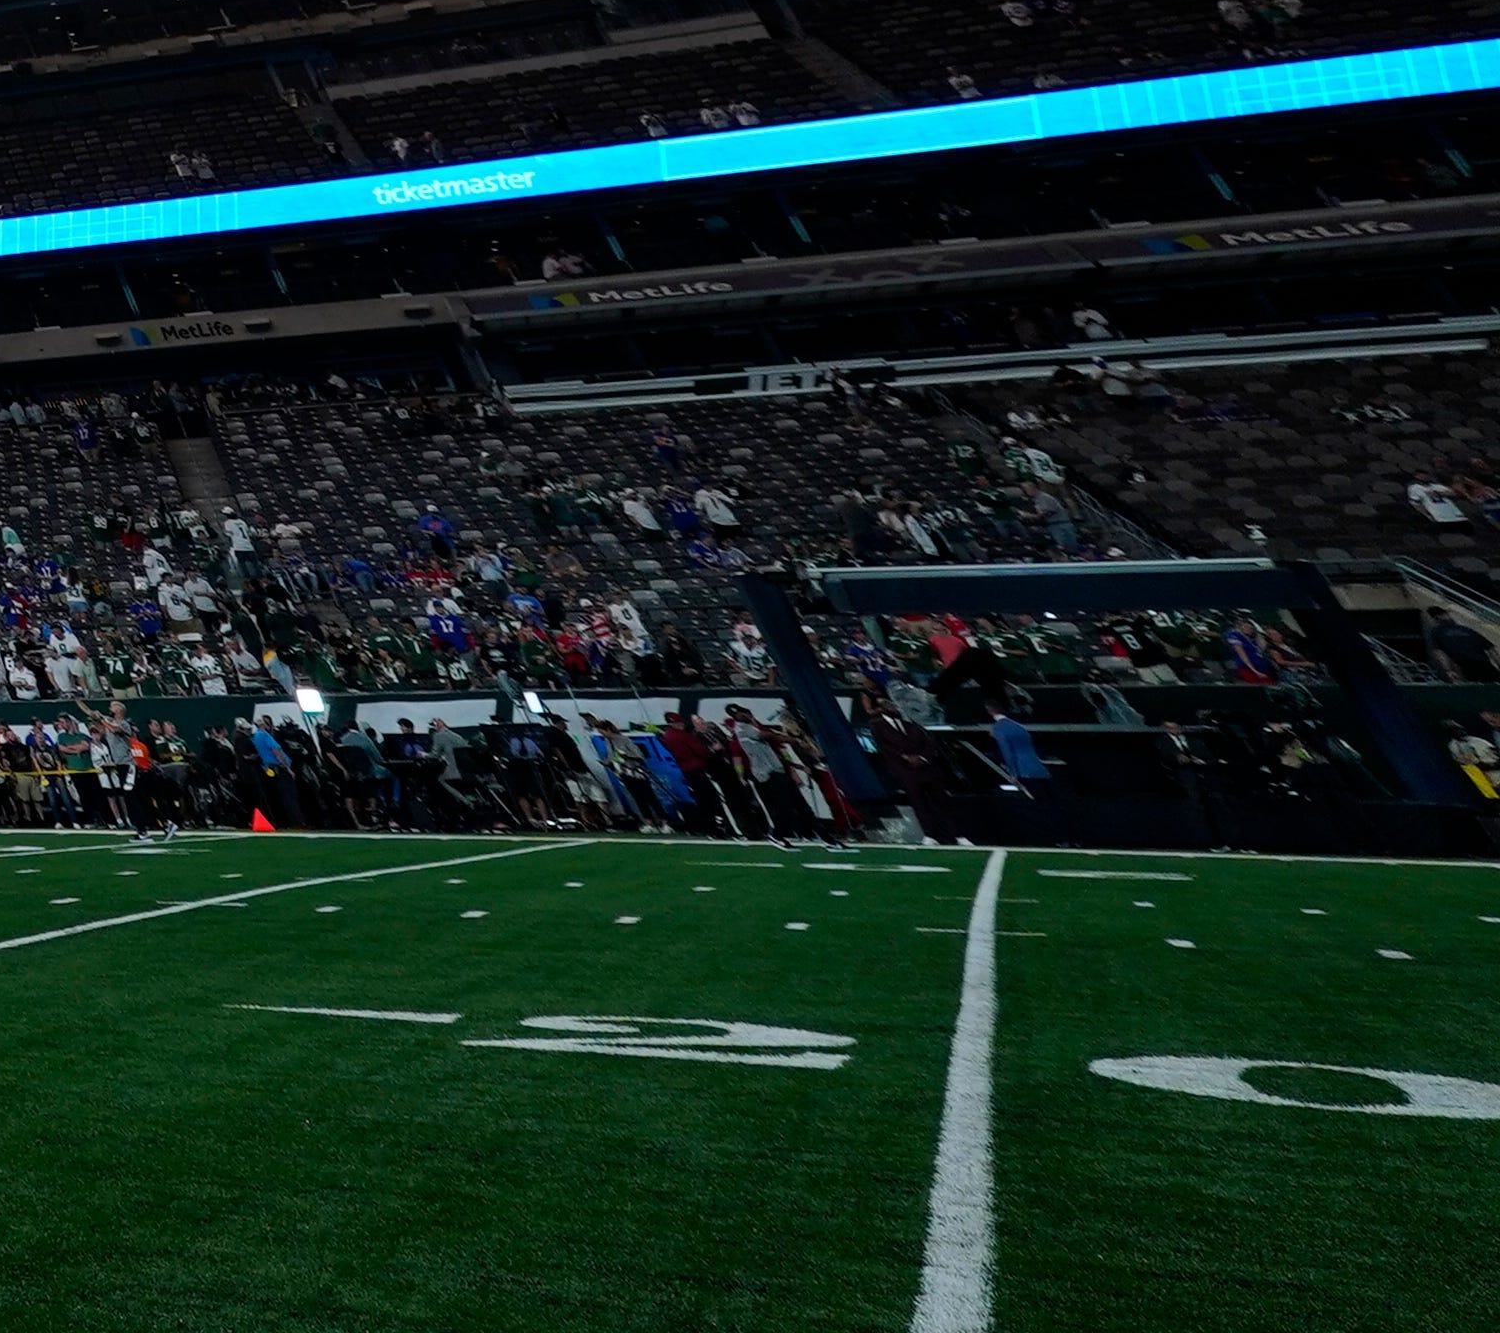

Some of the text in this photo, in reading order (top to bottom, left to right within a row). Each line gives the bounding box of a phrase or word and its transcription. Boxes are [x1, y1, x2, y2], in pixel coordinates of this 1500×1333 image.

[372, 170, 537, 206] ticketmaster
[1220, 221, 1412, 246] MetLife
[586, 281, 734, 303] MetLife
[159, 322, 234, 341] MetLife
